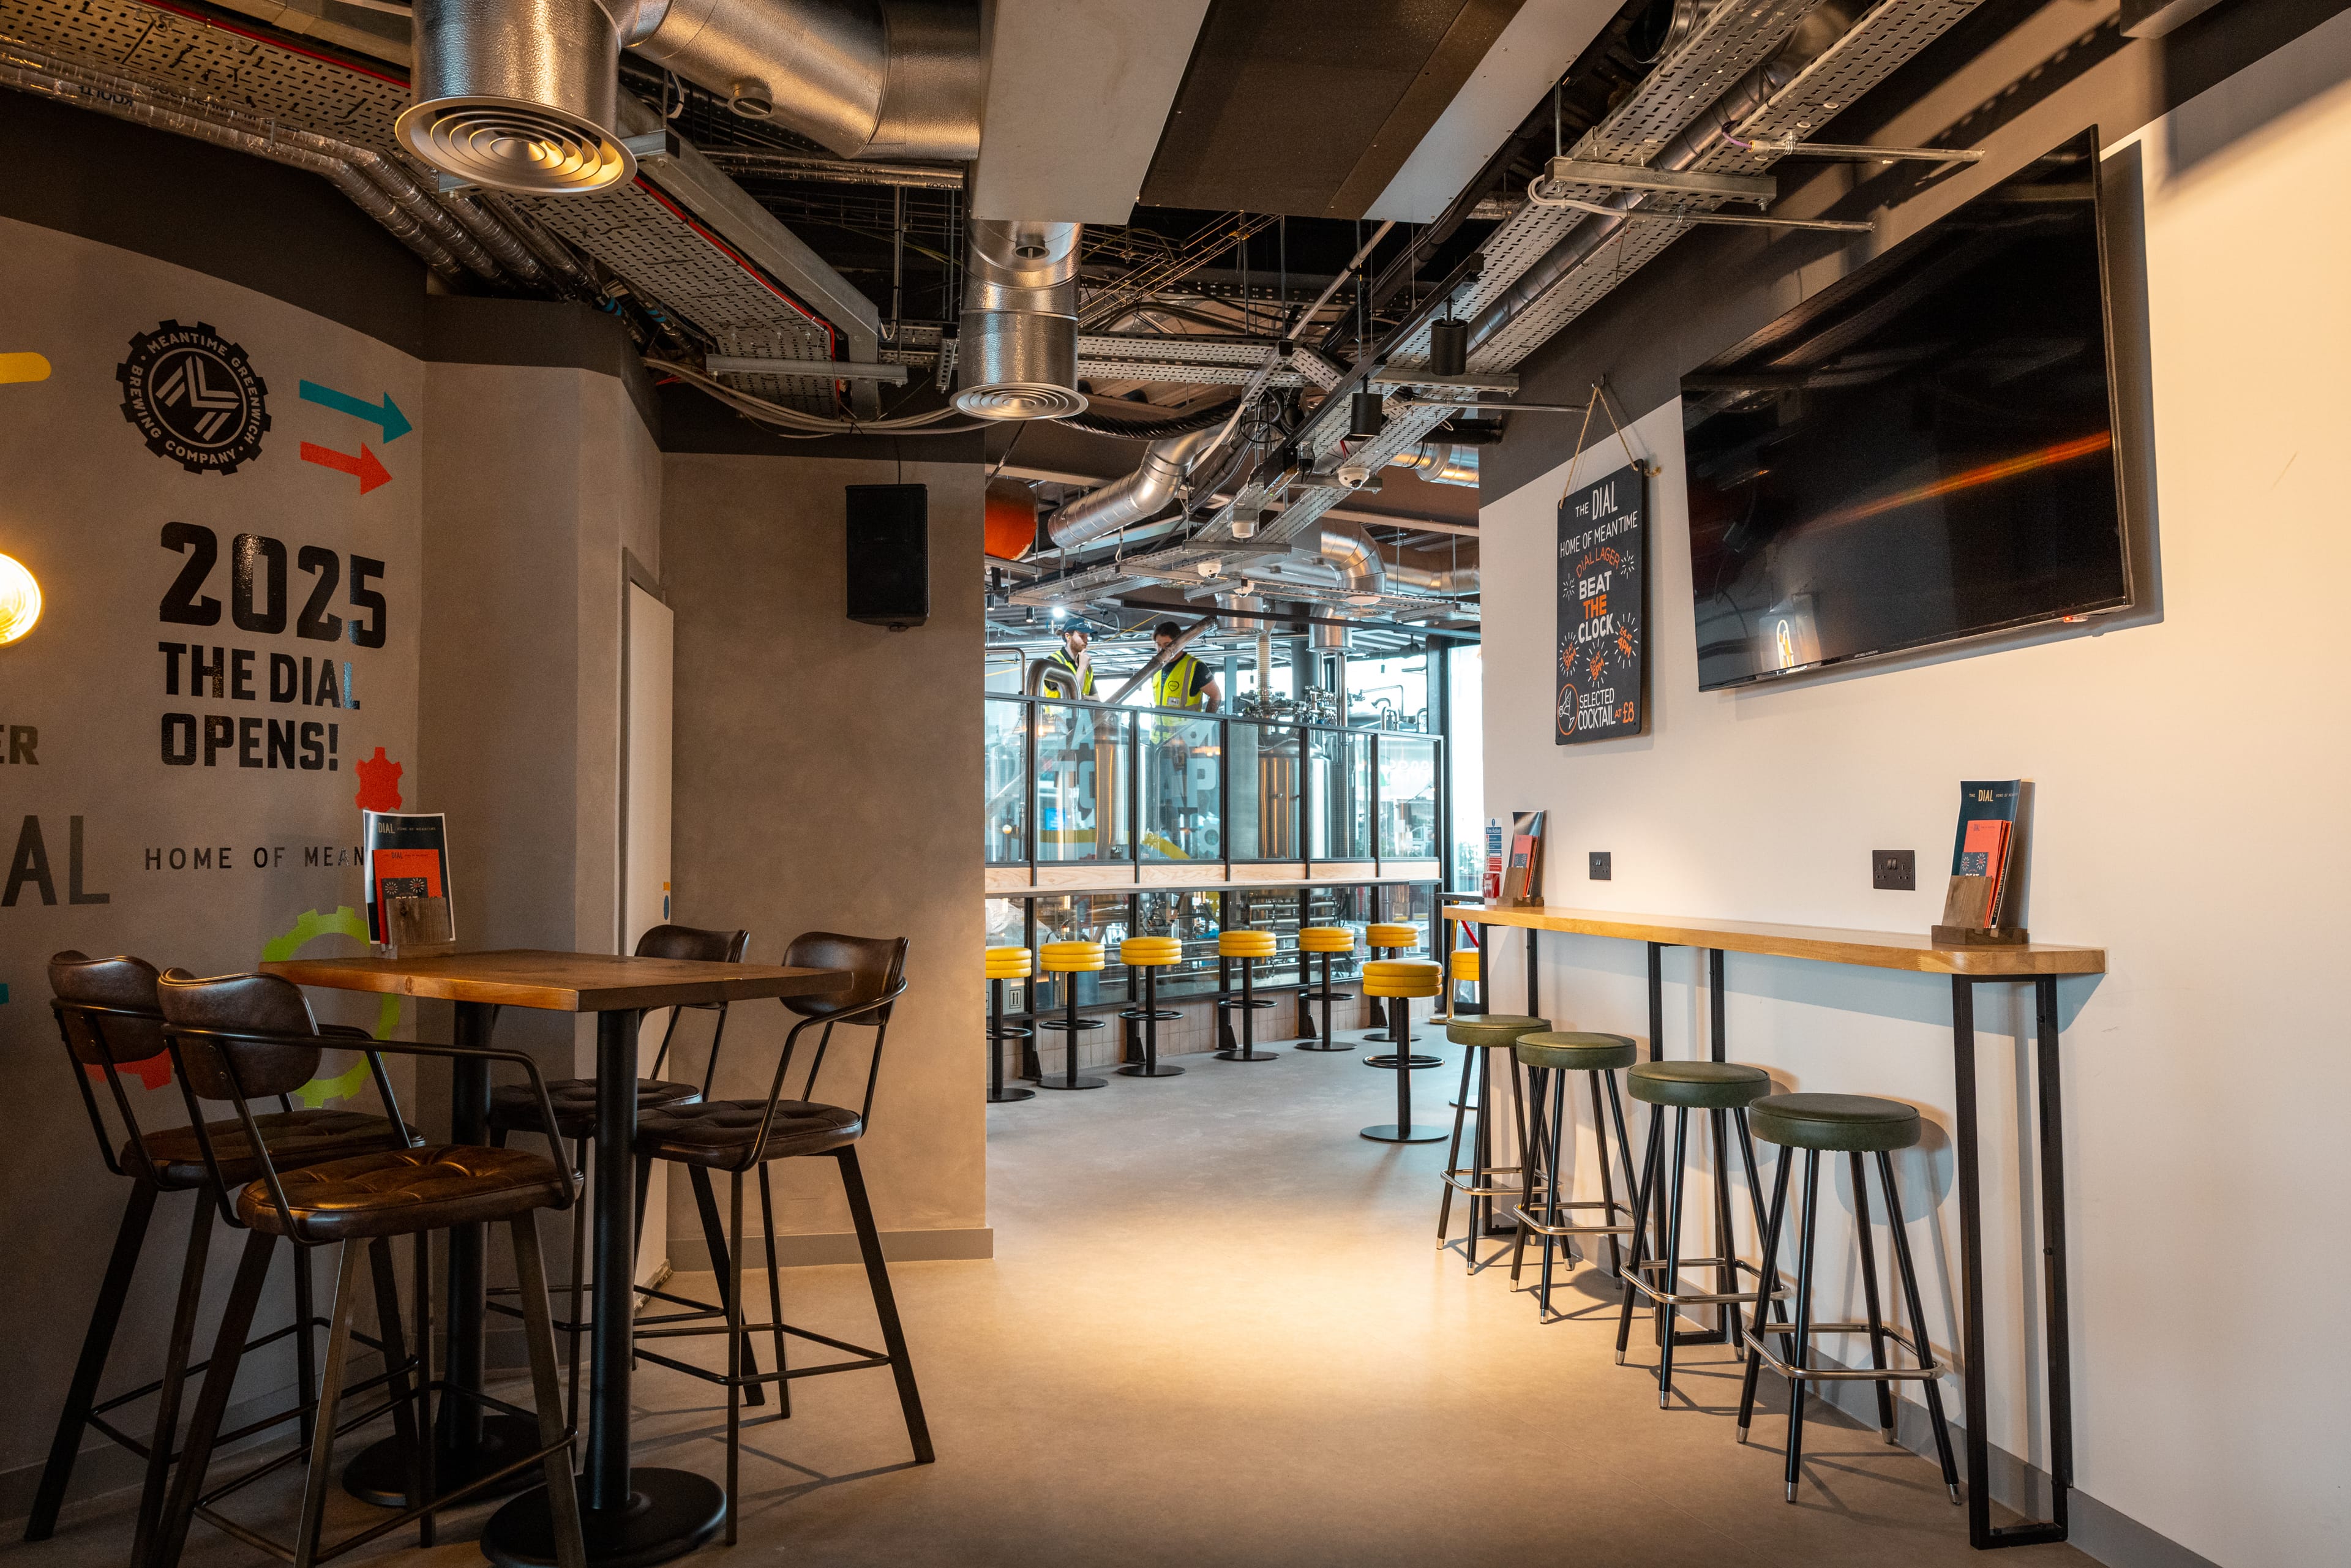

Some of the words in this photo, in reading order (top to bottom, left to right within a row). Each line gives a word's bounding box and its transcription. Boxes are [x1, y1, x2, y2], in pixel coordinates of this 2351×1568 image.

[146, 332, 228, 356] MEANTIME
[230, 357, 261, 445] GREENWICH
[129, 364, 162, 438] BREWING
[165, 440, 236, 465] COMPANY
[1575, 501, 1589, 517] THE
[1592, 481, 1618, 520] DIAL
[1559, 535, 1581, 558] HOME
[1582, 530, 1592, 550] OF
[1594, 510, 1638, 546] MEANTIME
[1575, 551, 1595, 578] DIAL
[1595, 547, 1621, 570] LAGER
[159, 522, 386, 649] 2025
[1579, 570, 1612, 601] BEAT
[1583, 594, 1607, 620] THE
[1578, 613, 1614, 644] CLOCK
[1618, 636, 1632, 658] 4PM
[158, 642, 256, 701] THE
[269, 653, 361, 710] DIAL
[1579, 688, 1614, 709] SELECTED
[1578, 704, 1616, 730] COCKTAIL
[1614, 708, 1622, 719] AT
[1622, 700, 1635, 724] £8
[160, 712, 339, 771] OPENS!
[1978, 789, 1994, 802] DIAL
[378, 822, 396, 834] DIAL
[145, 847, 233, 871] HOME
[253, 846, 286, 868] OF
[304, 845, 364, 868] MEAN
